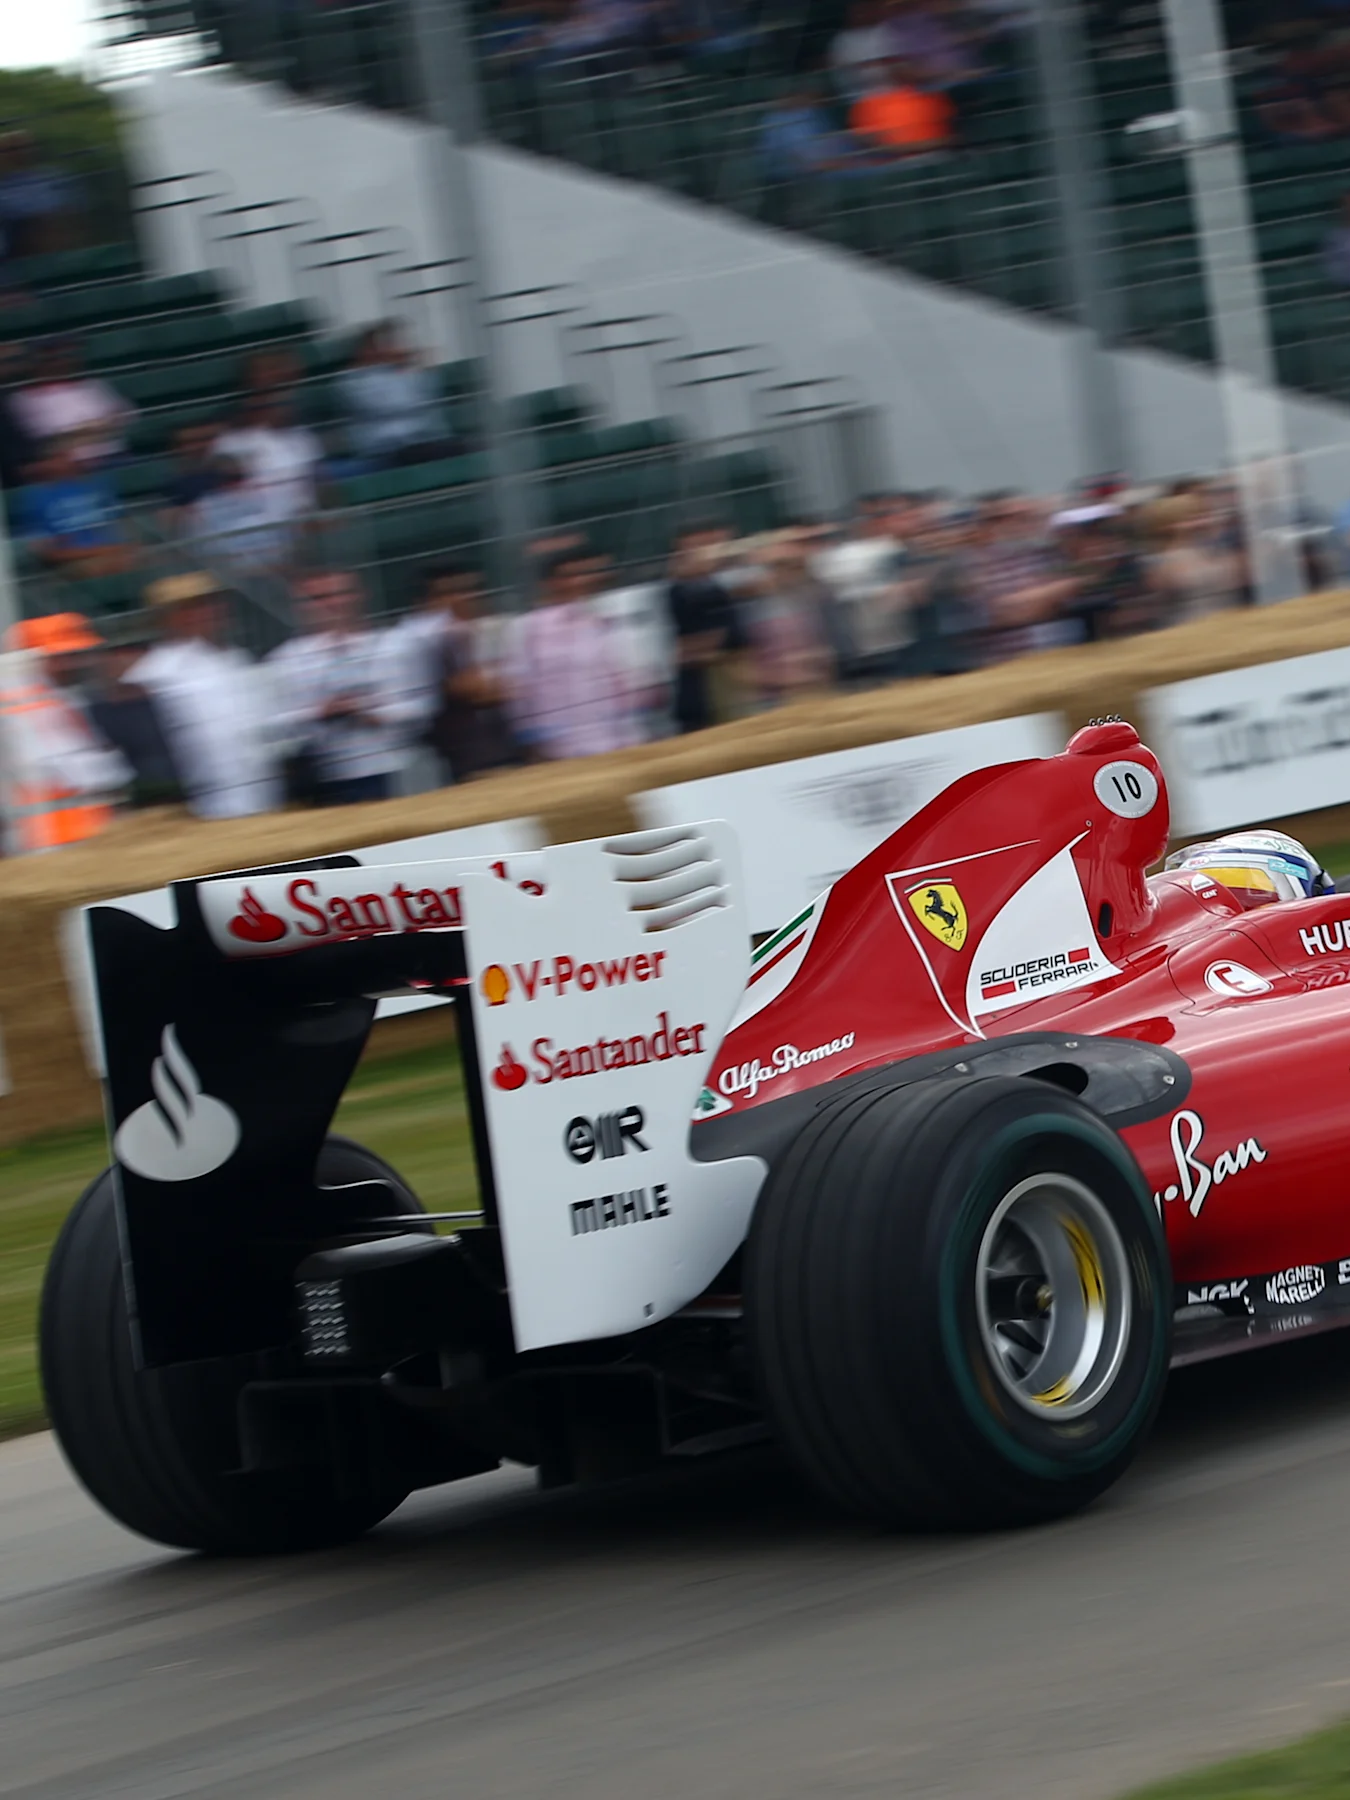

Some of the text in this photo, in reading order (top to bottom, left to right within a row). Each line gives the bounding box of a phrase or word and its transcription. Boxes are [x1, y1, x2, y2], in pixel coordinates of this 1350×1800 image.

[1111, 772, 1142, 803] 10
[512, 950, 668, 1001] V-Power
[980, 953, 1066, 986] SCUDERIA
[1018, 961, 1096, 991] FERRARI
[530, 1010, 707, 1085] Santander
[718, 1031, 856, 1099] Alfa Romeo
[568, 1182, 672, 1236] MAHLE
